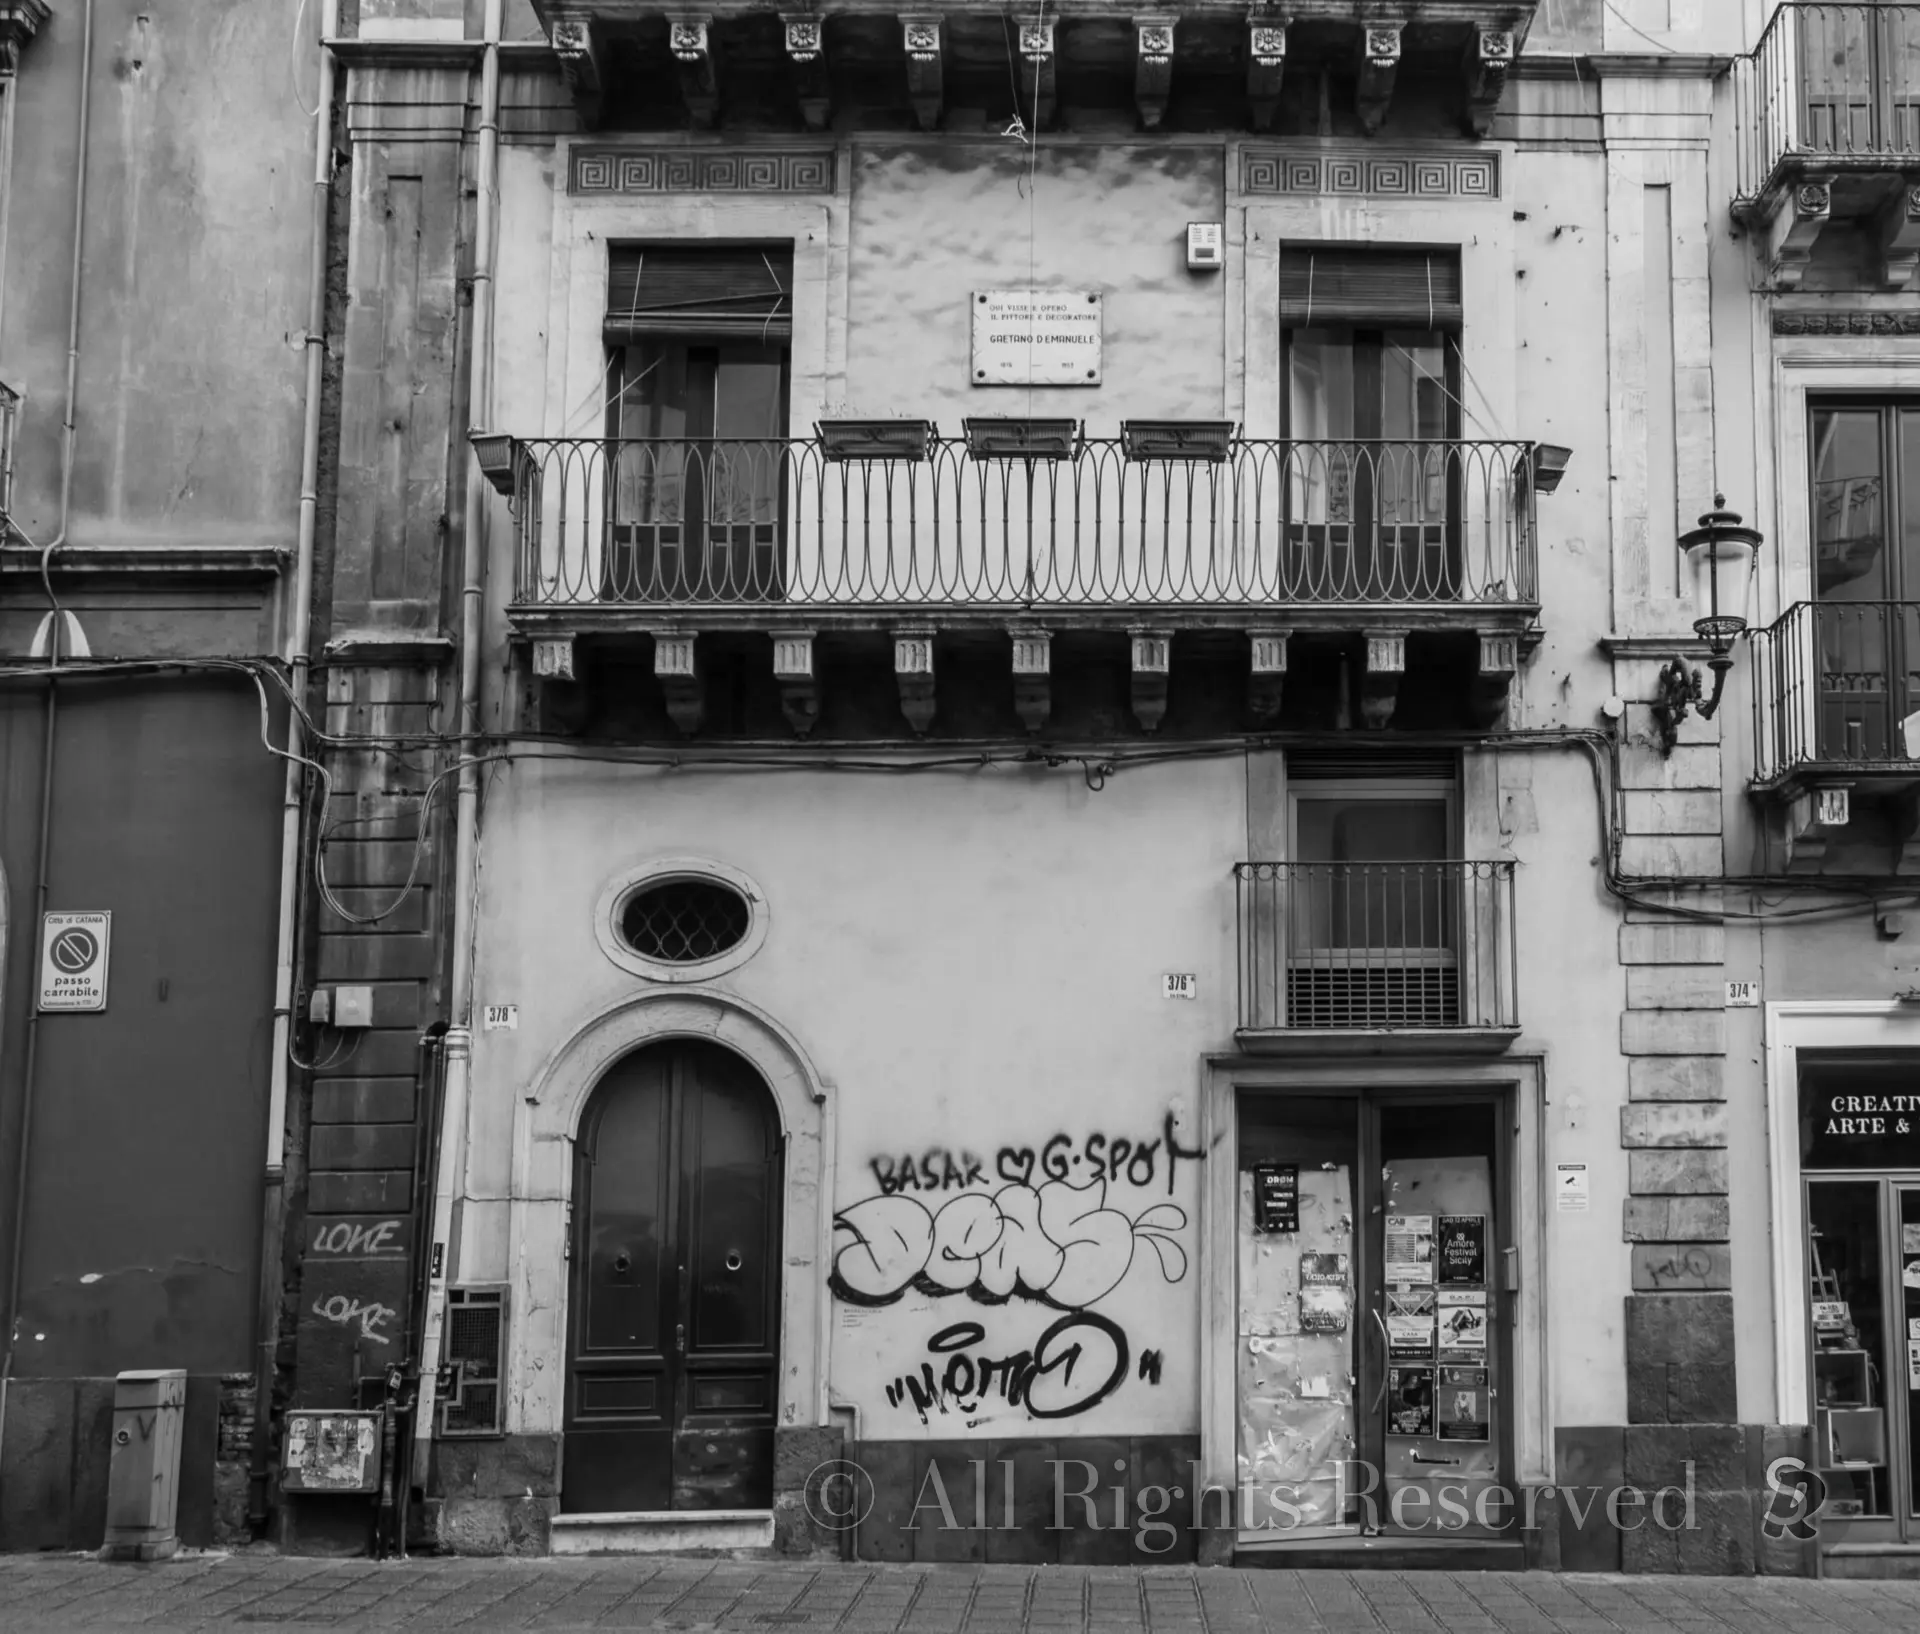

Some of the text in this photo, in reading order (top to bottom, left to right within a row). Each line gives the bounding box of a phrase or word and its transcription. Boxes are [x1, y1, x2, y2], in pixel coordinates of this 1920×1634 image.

[989, 334, 1033, 344] GAETANO
[54, 977, 91, 987] passo
[1168, 975, 1187, 991] 376
[44, 987, 99, 997] carrabile
[1730, 983, 1749, 998] 374
[489, 1006, 508, 1022] 378
[1825, 1117, 1910, 1134] ARTE &
[1447, 1239, 1475, 1248] Amore
[1444, 1247, 1478, 1257] Festival
[1449, 1256, 1473, 1266] Sicily
